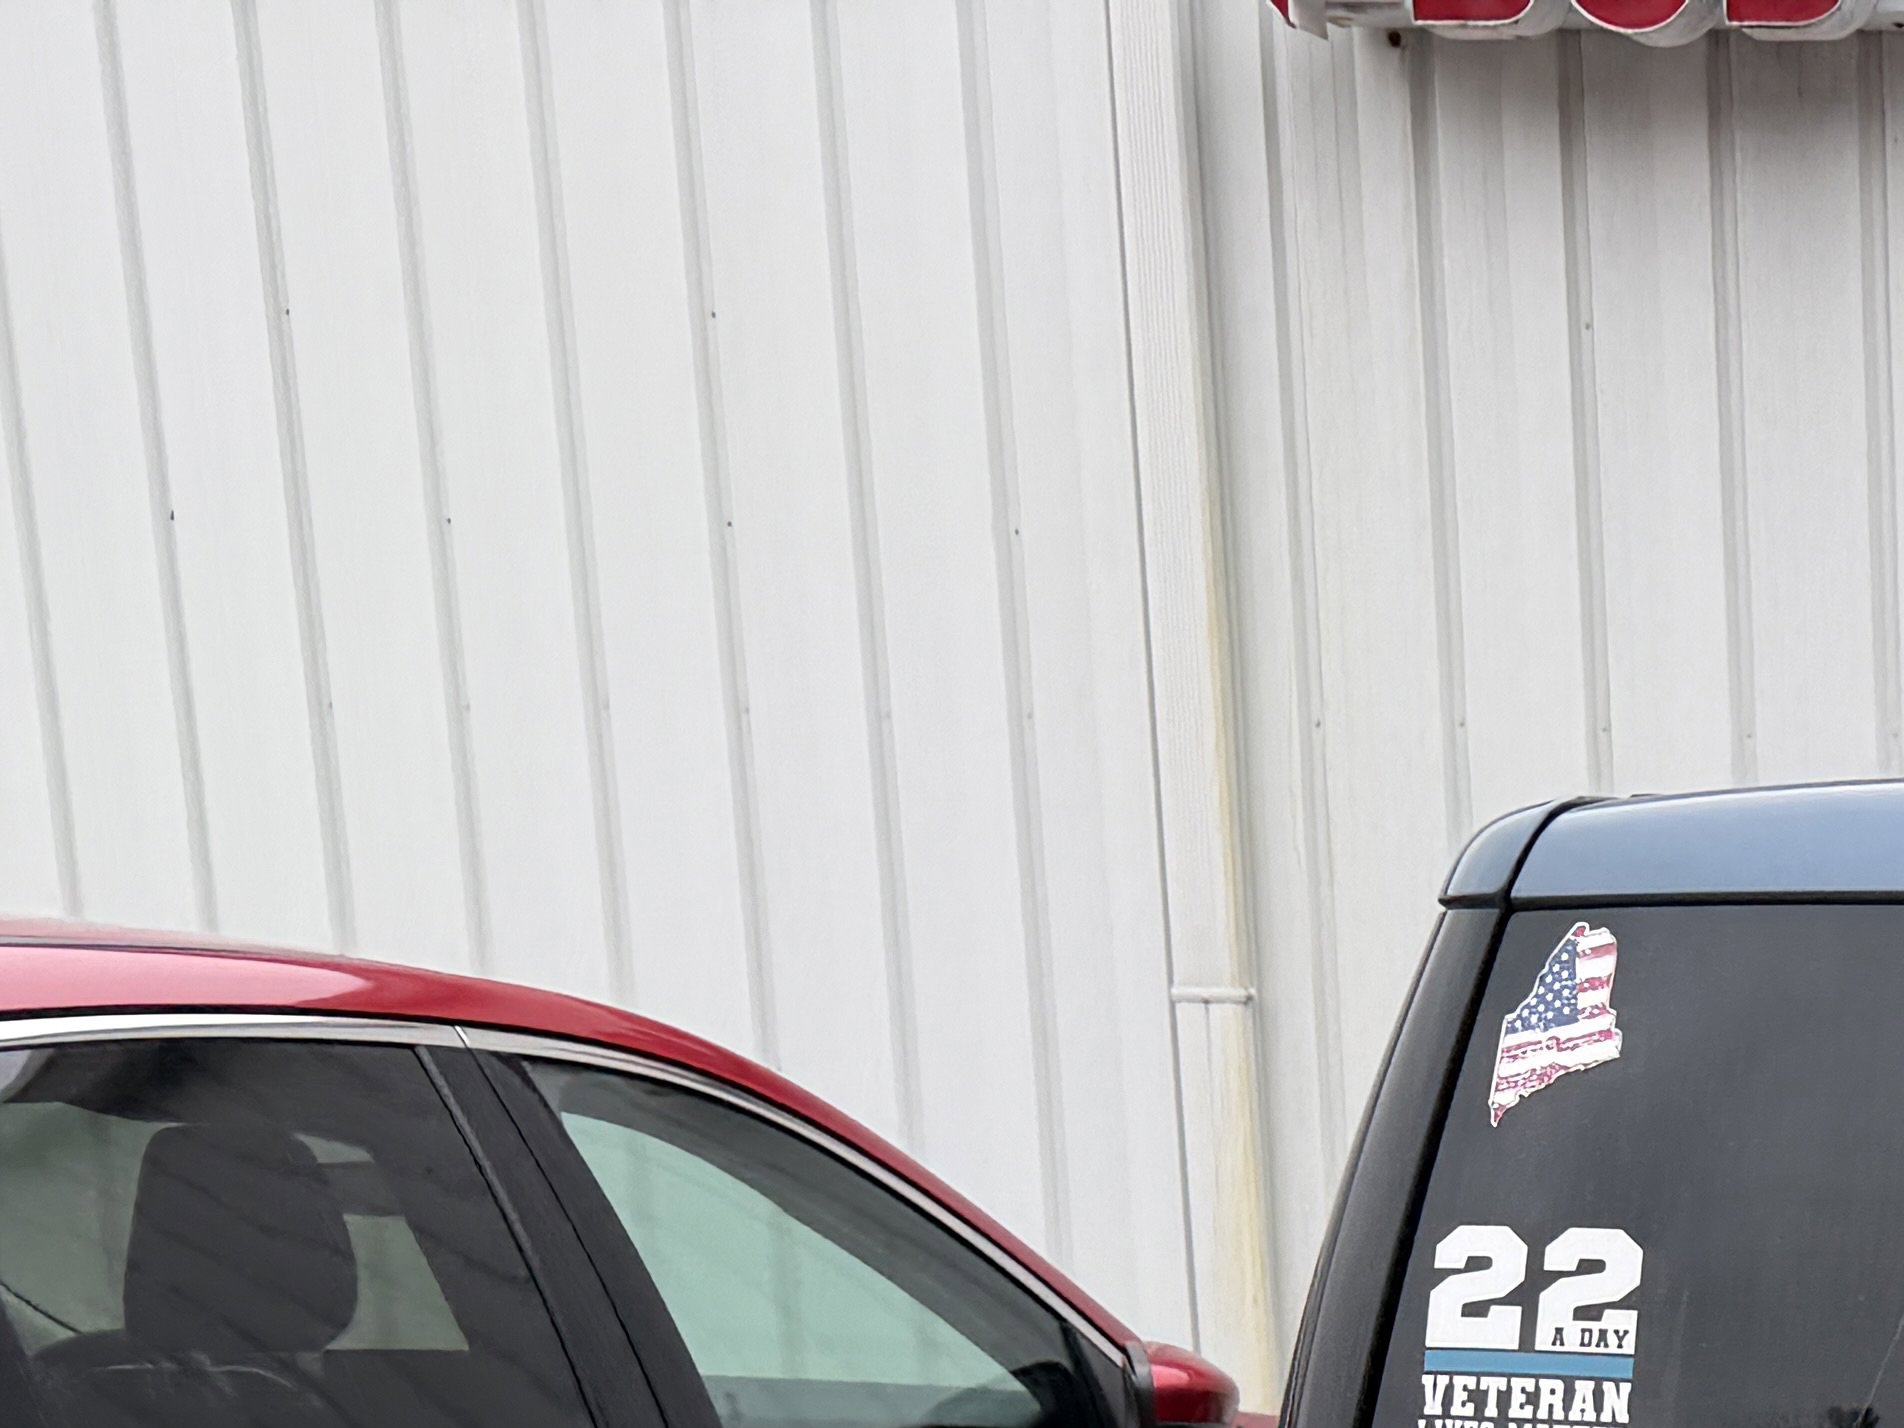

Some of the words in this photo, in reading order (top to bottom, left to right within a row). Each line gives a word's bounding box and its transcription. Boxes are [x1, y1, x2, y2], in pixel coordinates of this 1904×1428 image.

[1425, 1225, 1643, 1355] 22
[1551, 1327, 1565, 1347] A
[1579, 1328, 1629, 1349] DAY
[1422, 1374, 1632, 1424] VETERAN
